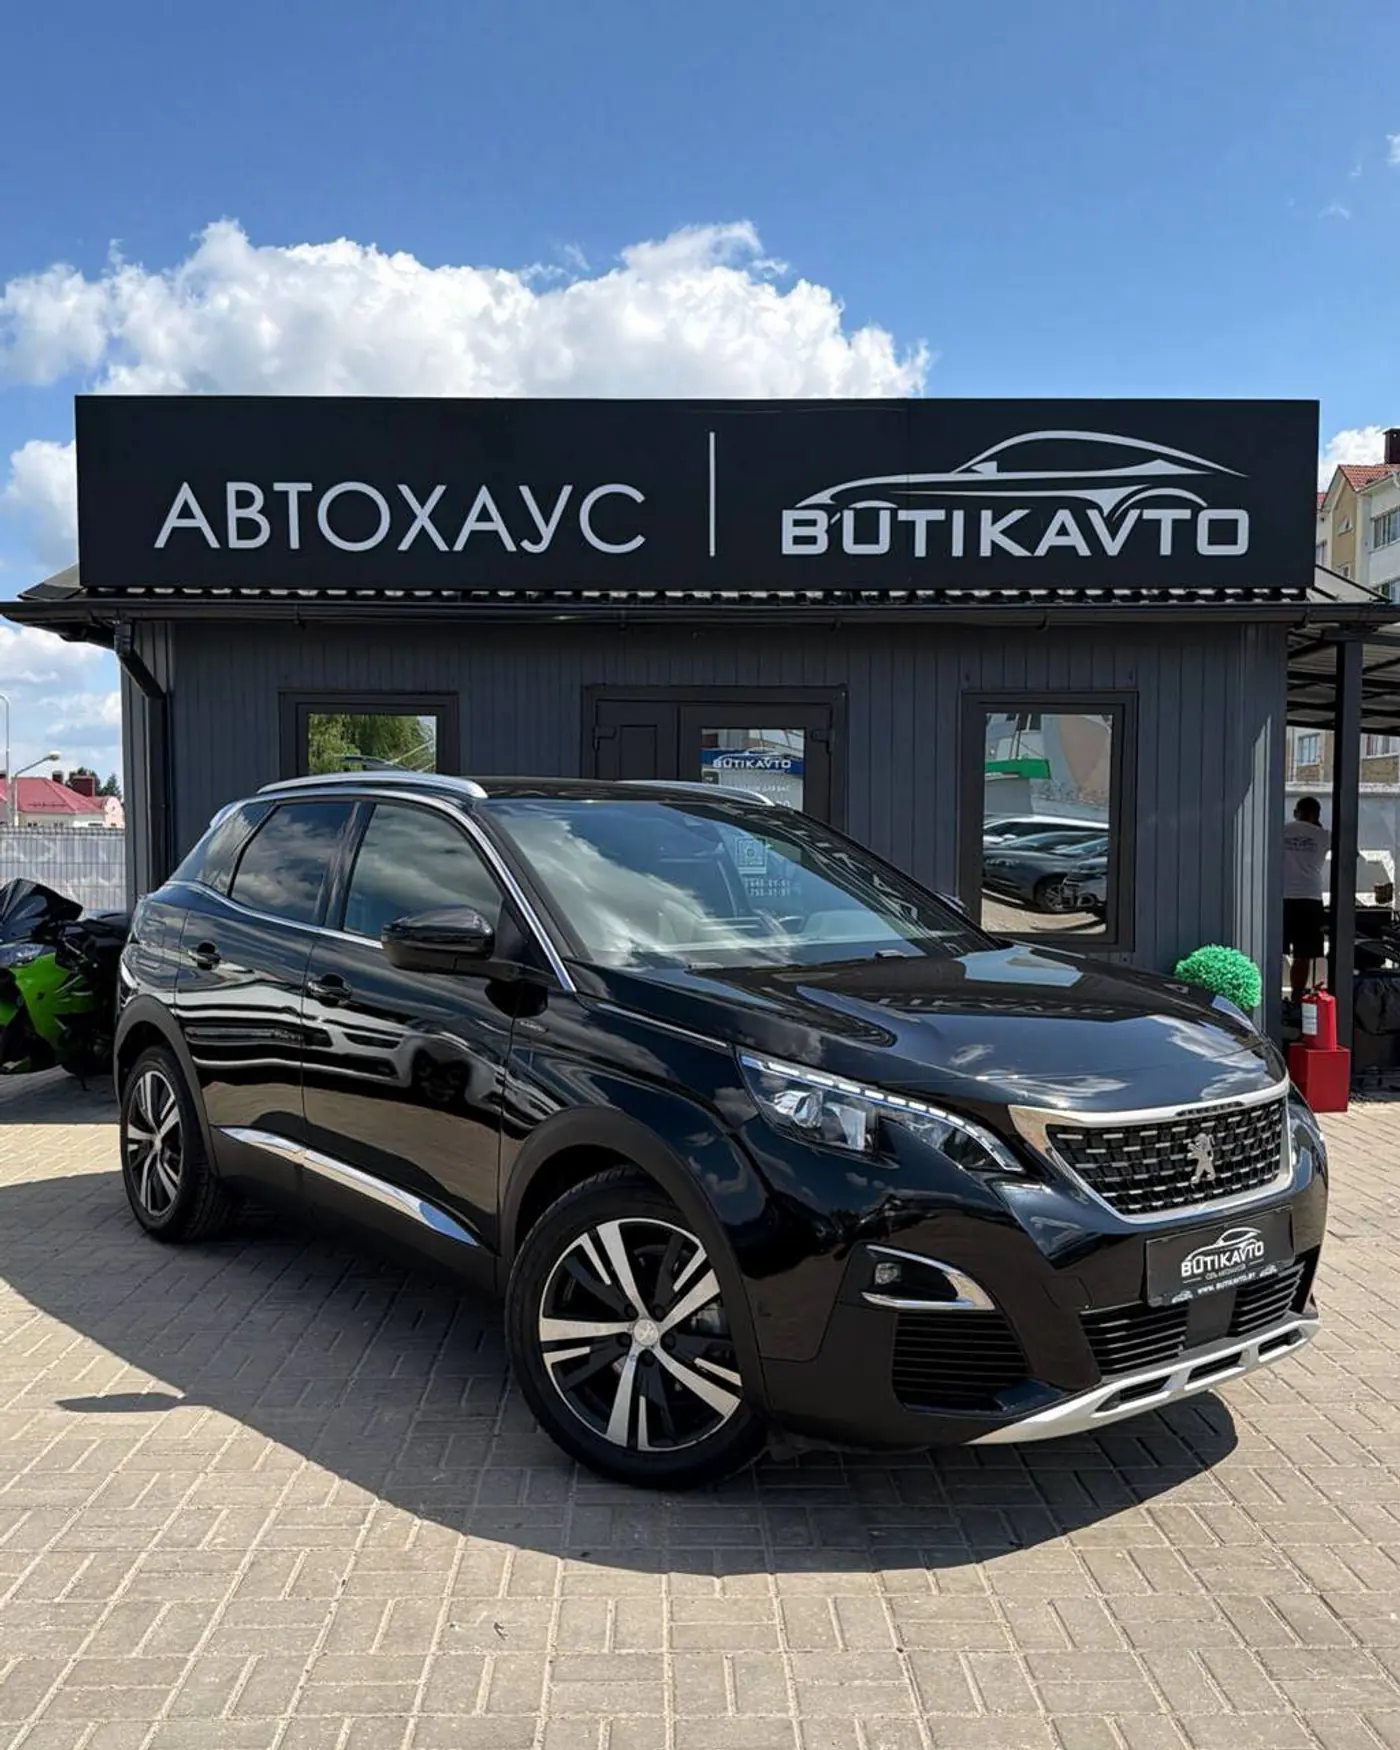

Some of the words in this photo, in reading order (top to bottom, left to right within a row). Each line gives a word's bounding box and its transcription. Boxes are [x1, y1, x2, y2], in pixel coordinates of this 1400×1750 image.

[153, 480, 647, 554] АВТОХАУС
[780, 507, 1250, 558] BUTIKAVTO
[712, 758, 792, 769] BUTIKAVTO
[1180, 1240, 1265, 1278] BUTIKAVTO
